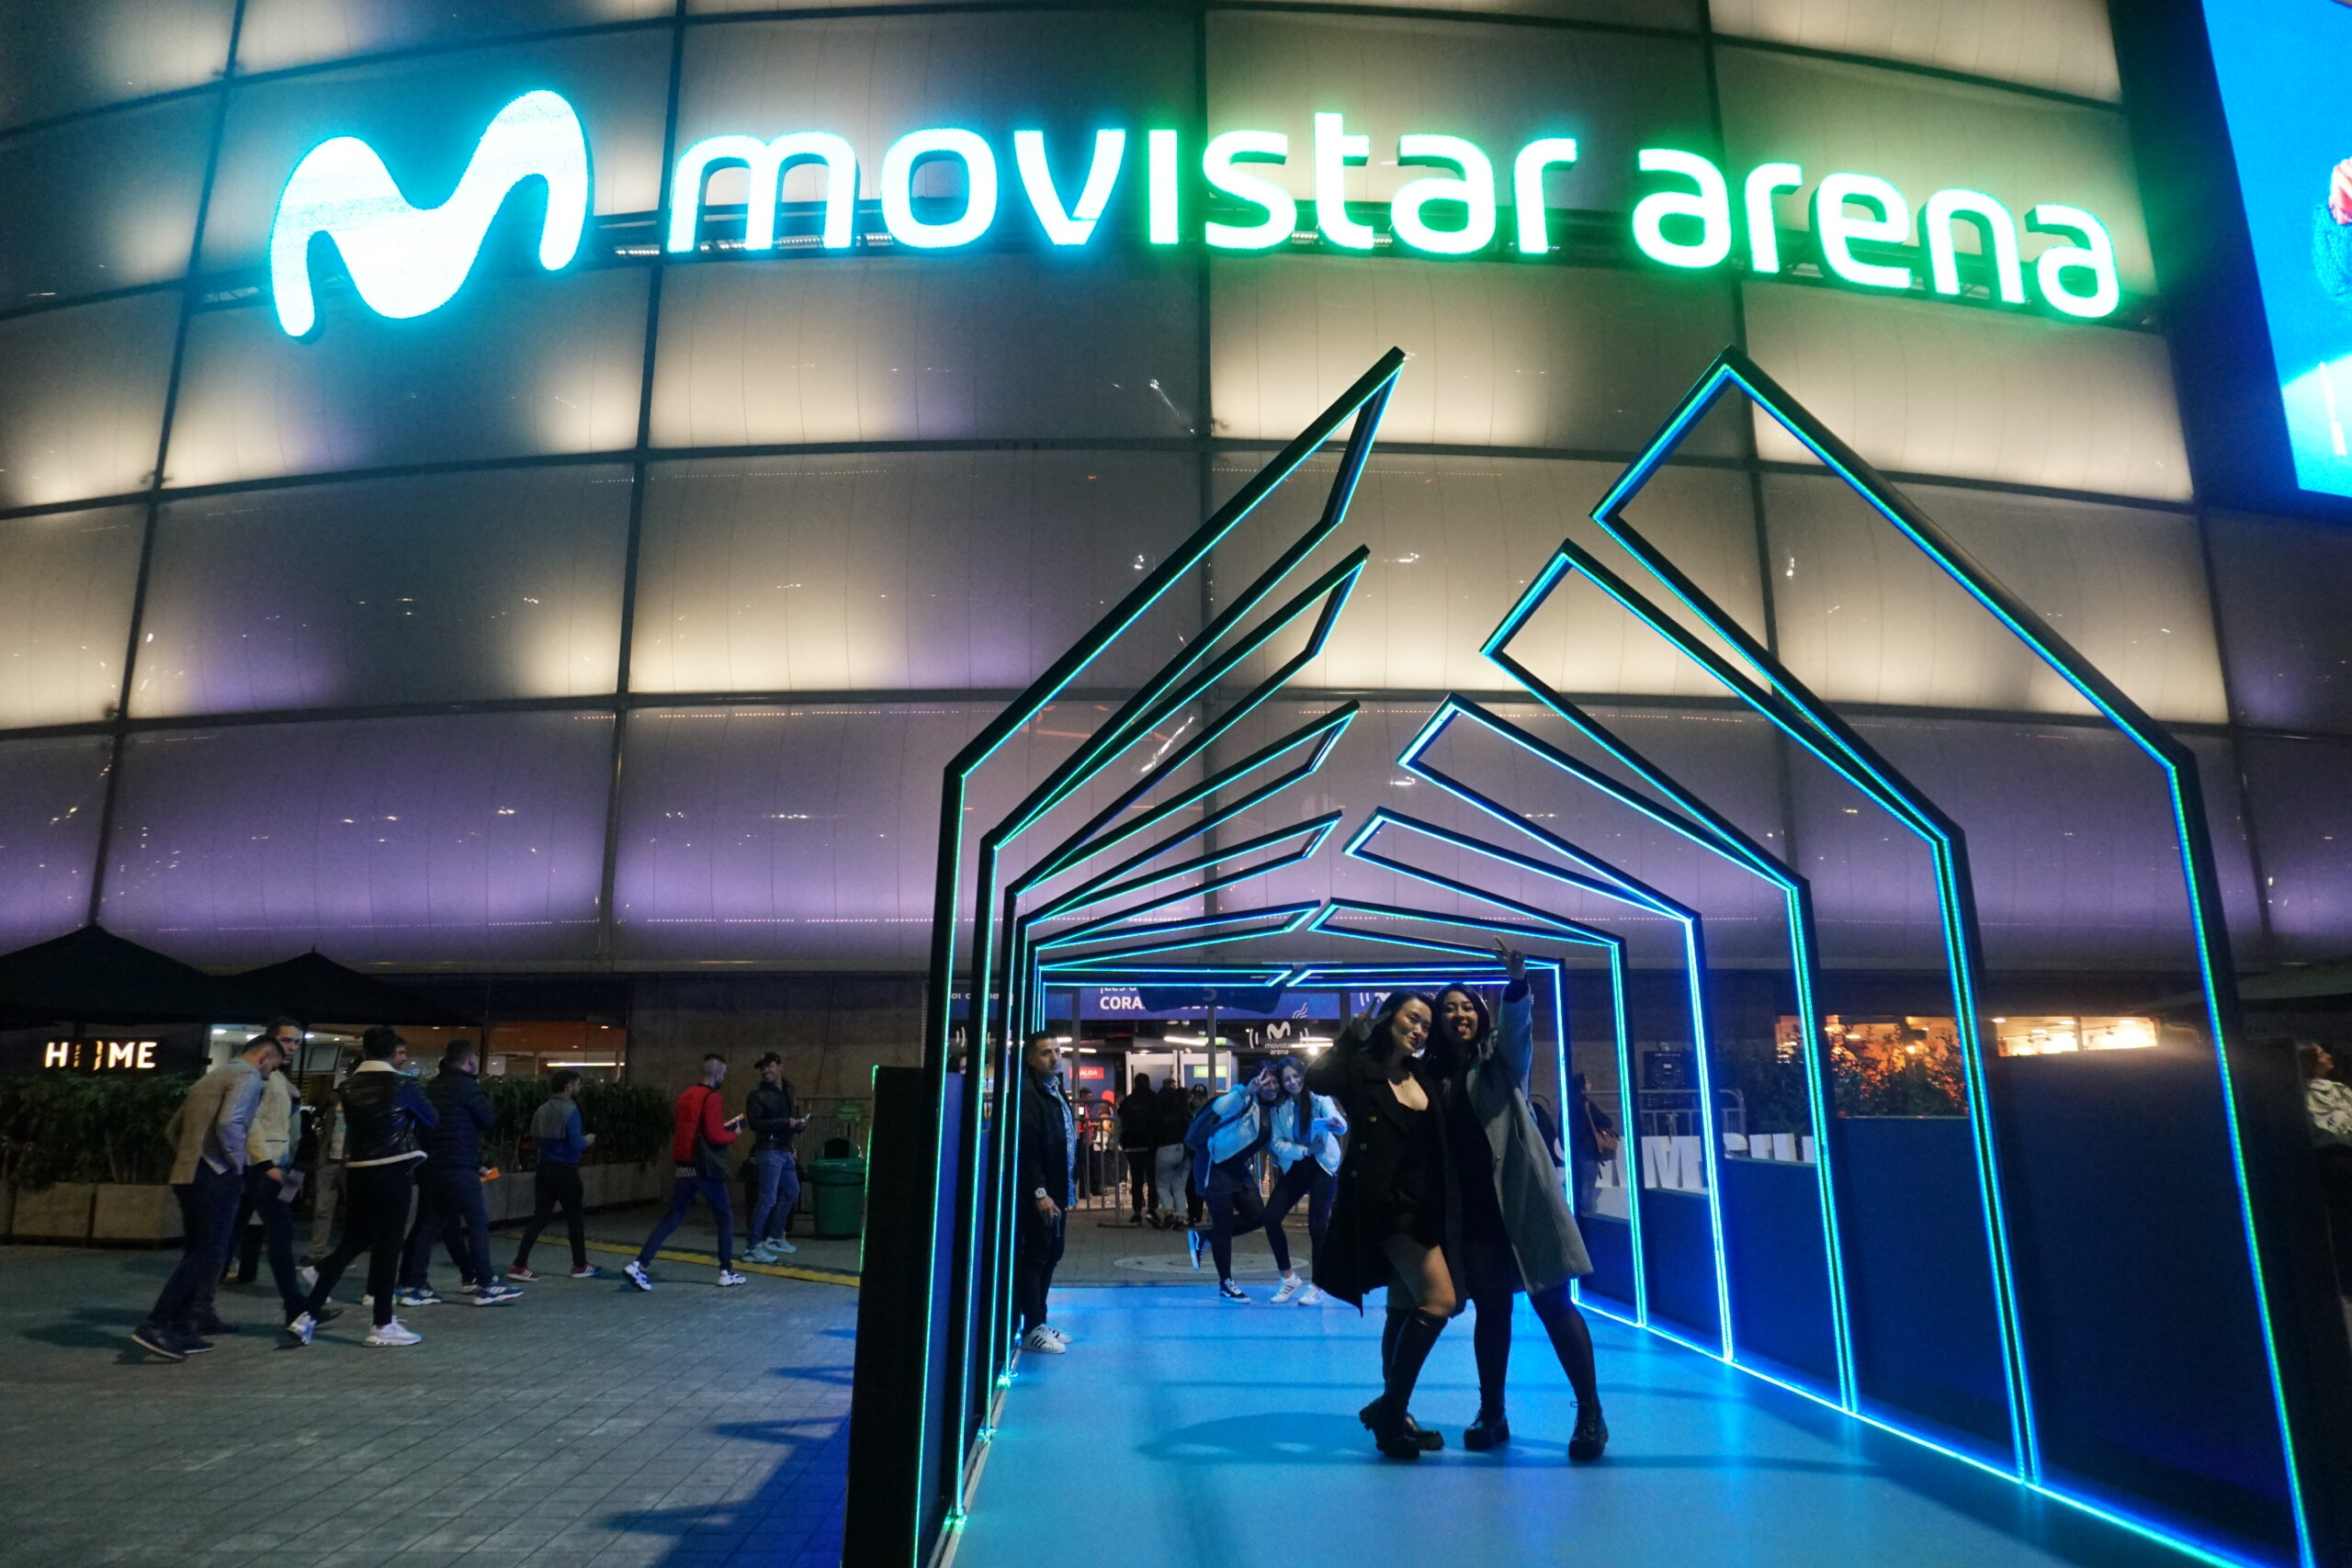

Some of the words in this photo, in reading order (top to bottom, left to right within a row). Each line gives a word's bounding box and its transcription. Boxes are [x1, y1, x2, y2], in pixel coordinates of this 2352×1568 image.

[667, 112, 1579, 255] movistar
[1632, 148, 2120, 318] arena
[1100, 996, 1147, 1010] CORA
